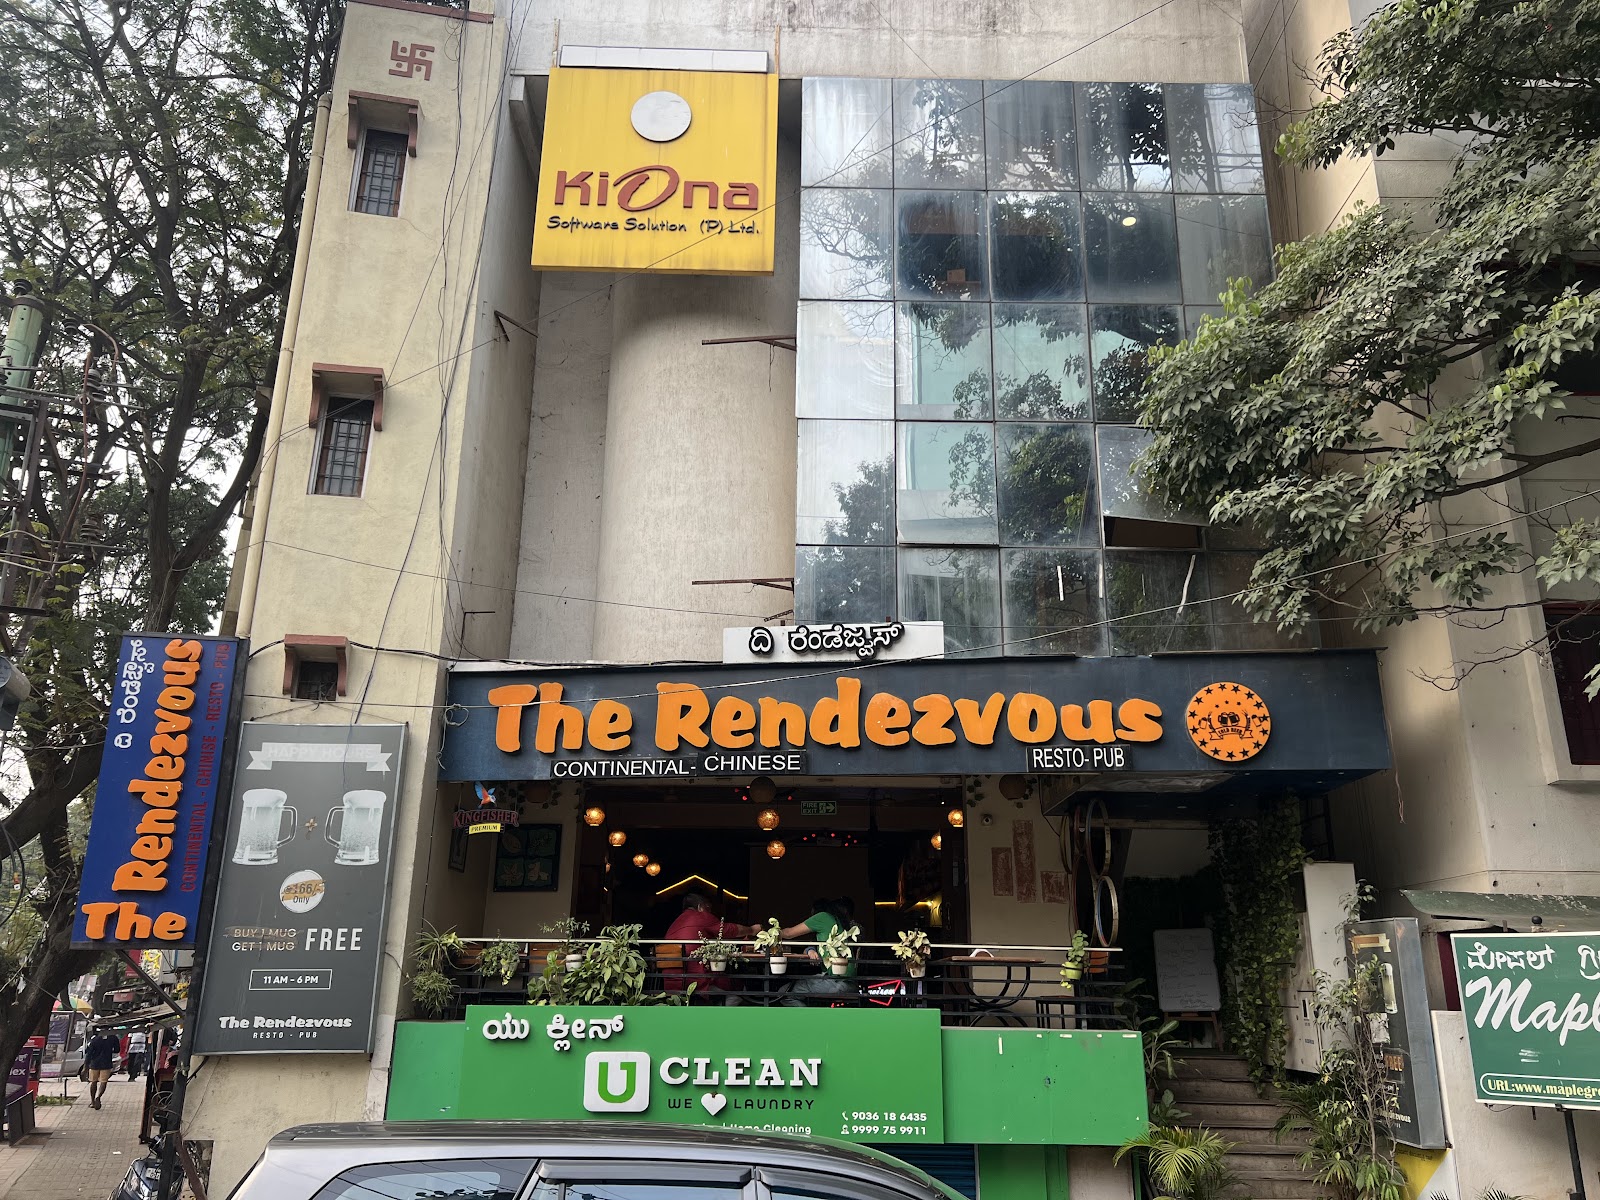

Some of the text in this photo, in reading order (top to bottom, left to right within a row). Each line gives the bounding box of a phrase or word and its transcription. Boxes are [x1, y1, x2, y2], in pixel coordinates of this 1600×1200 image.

[547, 215, 760, 235] Software Solution (P) Ltd.
[750, 627, 773, 653] ದಿ
[214, 643, 230, 669] PUB
[206, 681, 225, 721] RESTO
[488, 676, 1163, 753] The Rendezvous
[114, 732, 133, 749] ದಿ
[703, 754, 801, 772] CHINESE
[1093, 747, 1125, 767] PUB
[81, 639, 203, 941] The Rendezvous
[453, 809, 520, 828] KINGFISHER
[470, 824, 499, 832] PREMIUM
[180, 800, 208, 893] CONTINENTAL
[293, 895, 310, 905] Only
[234, 928, 258, 938] BUY
[268, 928, 297, 938] MUG
[305, 928, 363, 951] FREE
[231, 942, 255, 951] GET
[266, 942, 295, 951] MUG
[263, 975, 272, 984] 11
[272, 975, 289, 984] AM
[296, 975, 302, 984] 6
[303, 975, 319, 984] PM
[218, 1015, 353, 1029] The Rendezvous
[299, 1031, 318, 1039] PUB
[482, 1012, 624, 1051] ಯು ಕ್ಲೀನ್
[597, 1057, 823, 1104] U CLEAN
[667, 1098, 815, 1110] WE LAUNDRY
[851, 1112, 927, 1122] 9036 18 6435
[851, 1125, 927, 1135] 9999 75 9911
